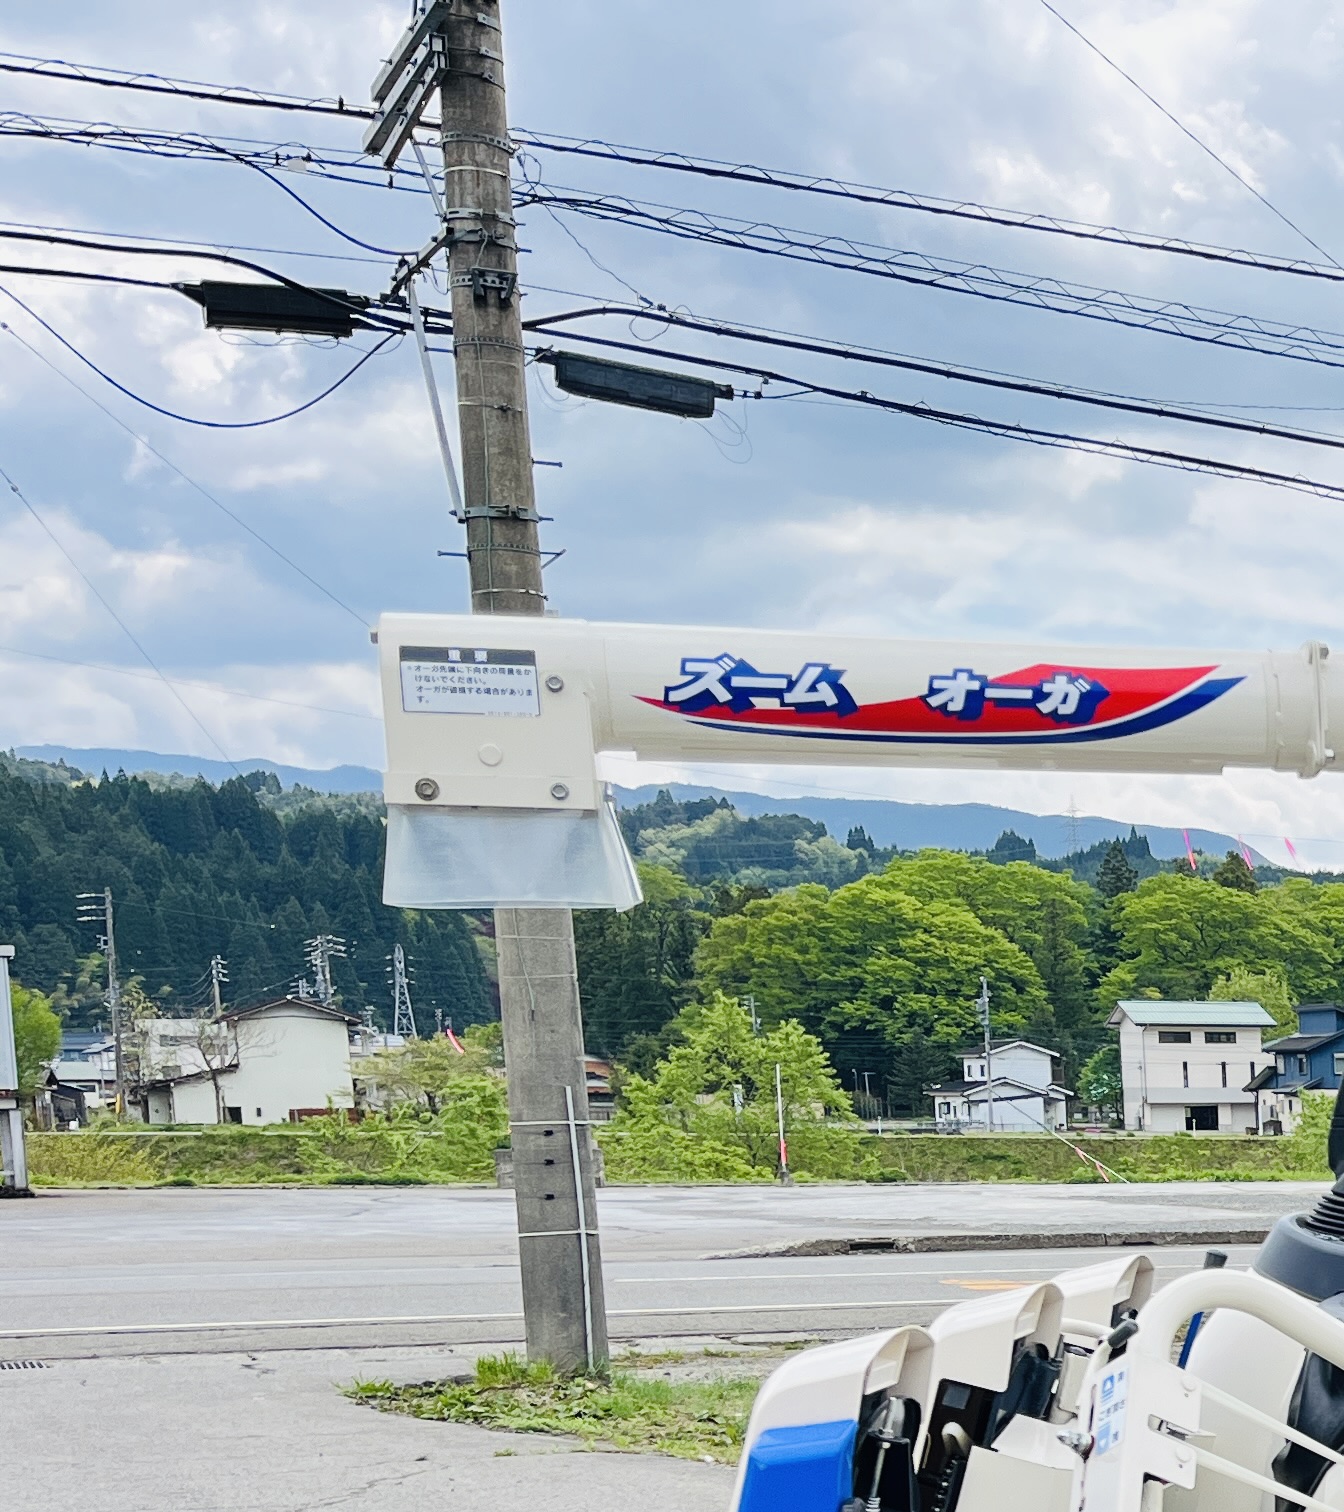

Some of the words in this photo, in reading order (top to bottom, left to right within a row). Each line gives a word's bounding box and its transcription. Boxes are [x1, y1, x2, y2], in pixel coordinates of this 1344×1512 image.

[666, 654, 853, 712] ズーム
[924, 670, 1096, 718] オーガ
